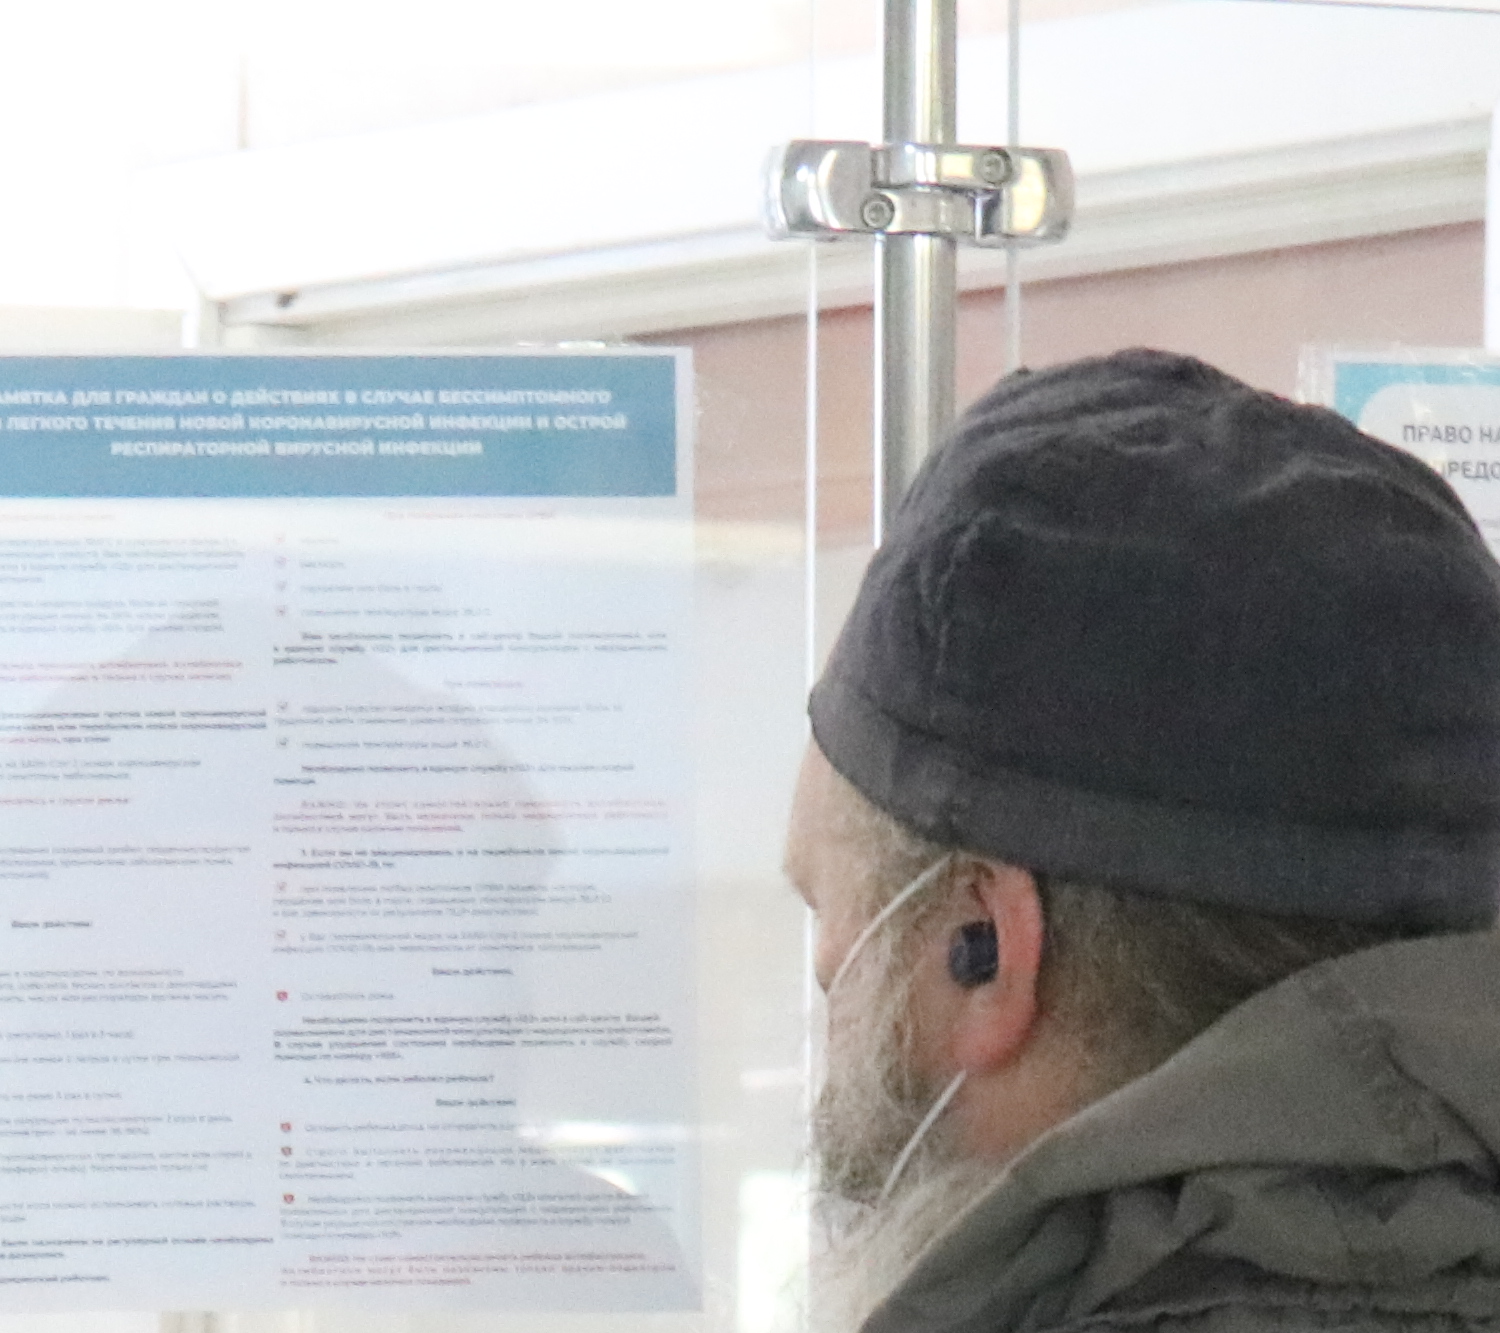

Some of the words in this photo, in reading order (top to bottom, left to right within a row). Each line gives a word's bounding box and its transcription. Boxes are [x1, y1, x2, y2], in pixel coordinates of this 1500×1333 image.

[72, 390, 111, 407] ДЛЯ
[115, 390, 208, 407] ГРАЖДАН
[212, 391, 226, 404] О
[180, 413, 245, 430] НОВОЙ
[554, 412, 628, 429] ОСТРОЙ
[1402, 424, 1472, 444] ПРАВО
